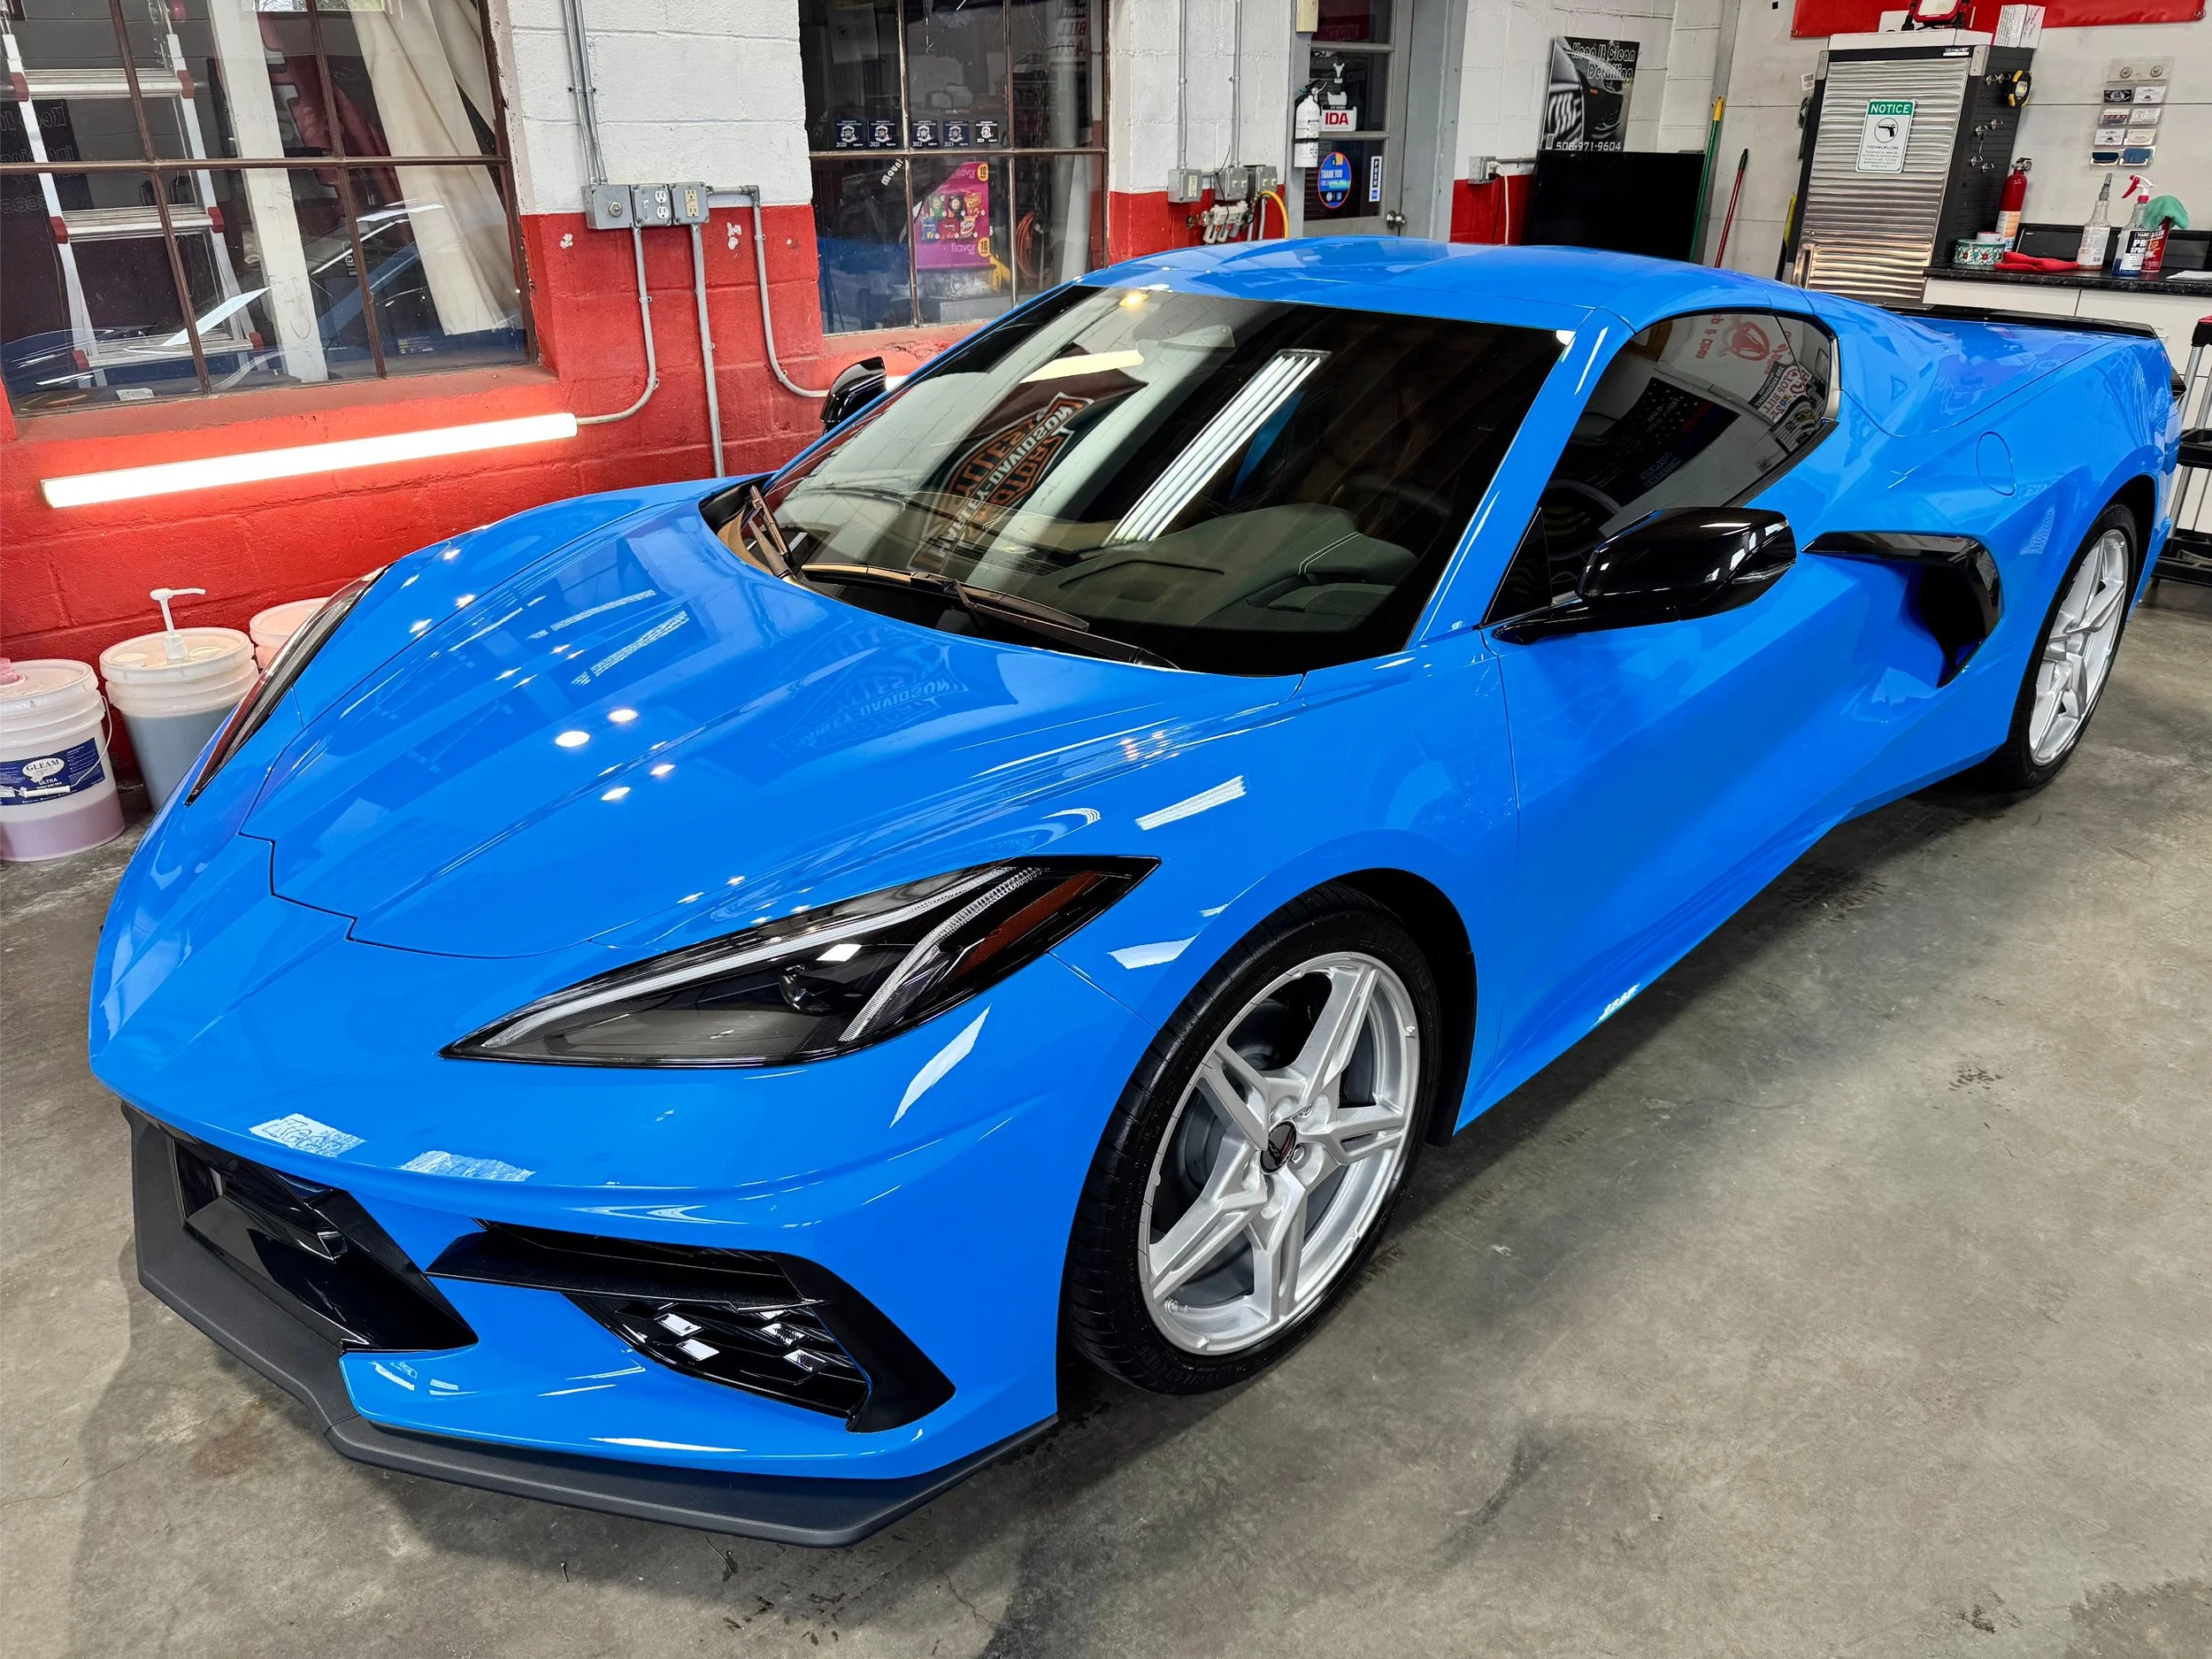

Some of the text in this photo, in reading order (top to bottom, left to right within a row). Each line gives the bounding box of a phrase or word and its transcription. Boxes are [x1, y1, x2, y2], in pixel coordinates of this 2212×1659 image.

[1572, 42, 1635, 62] Keep It Clean
[1587, 63, 1633, 85] Detailing
[1870, 104, 1910, 113] NOTICE
[1325, 112, 1348, 126] IDA
[1334, 170, 1343, 179] YOU
[951, 242, 976, 253] flavor
[26, 759, 59, 772] GLEAM
